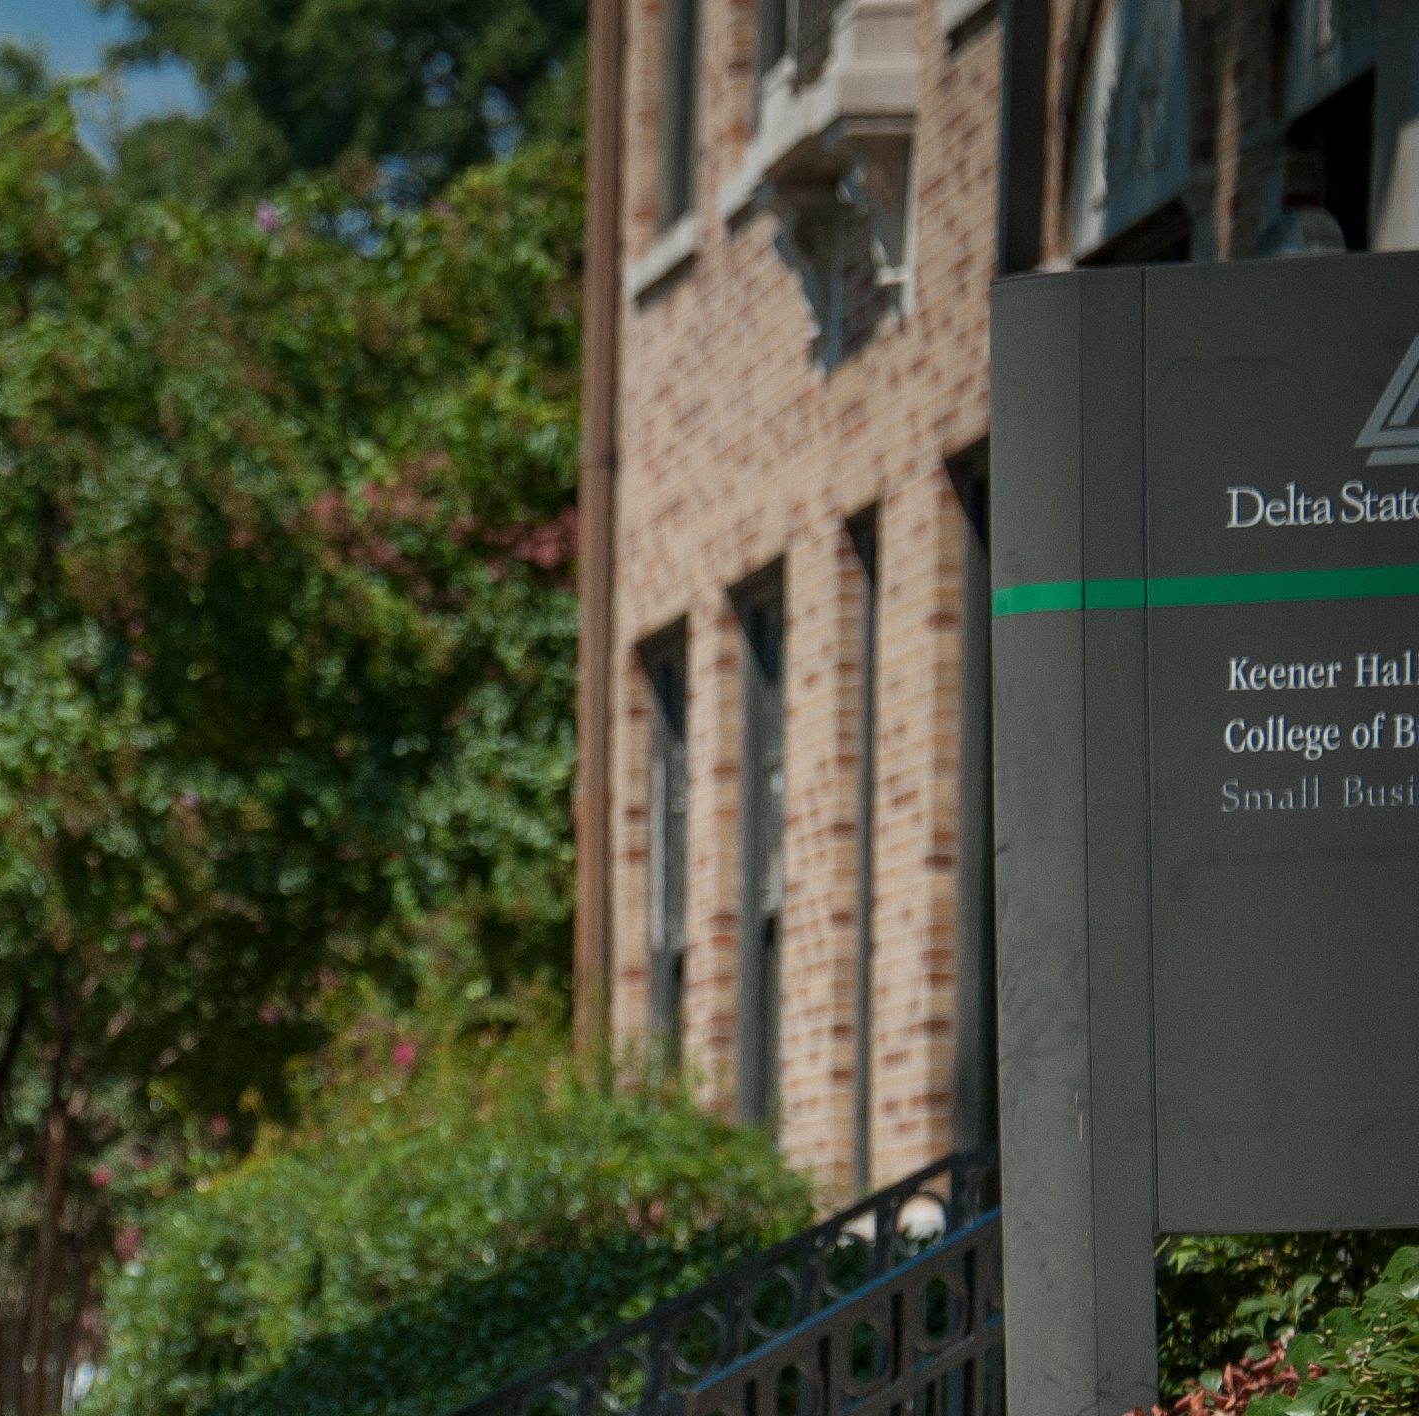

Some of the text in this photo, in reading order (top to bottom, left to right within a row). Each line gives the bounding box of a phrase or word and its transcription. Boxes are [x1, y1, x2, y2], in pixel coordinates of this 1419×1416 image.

[1226, 480, 1334, 529] Delta
[1227, 649, 1419, 691] Keener Hal
[1224, 710, 1419, 761] College of B
[1220, 774, 1416, 813] Small Busi
